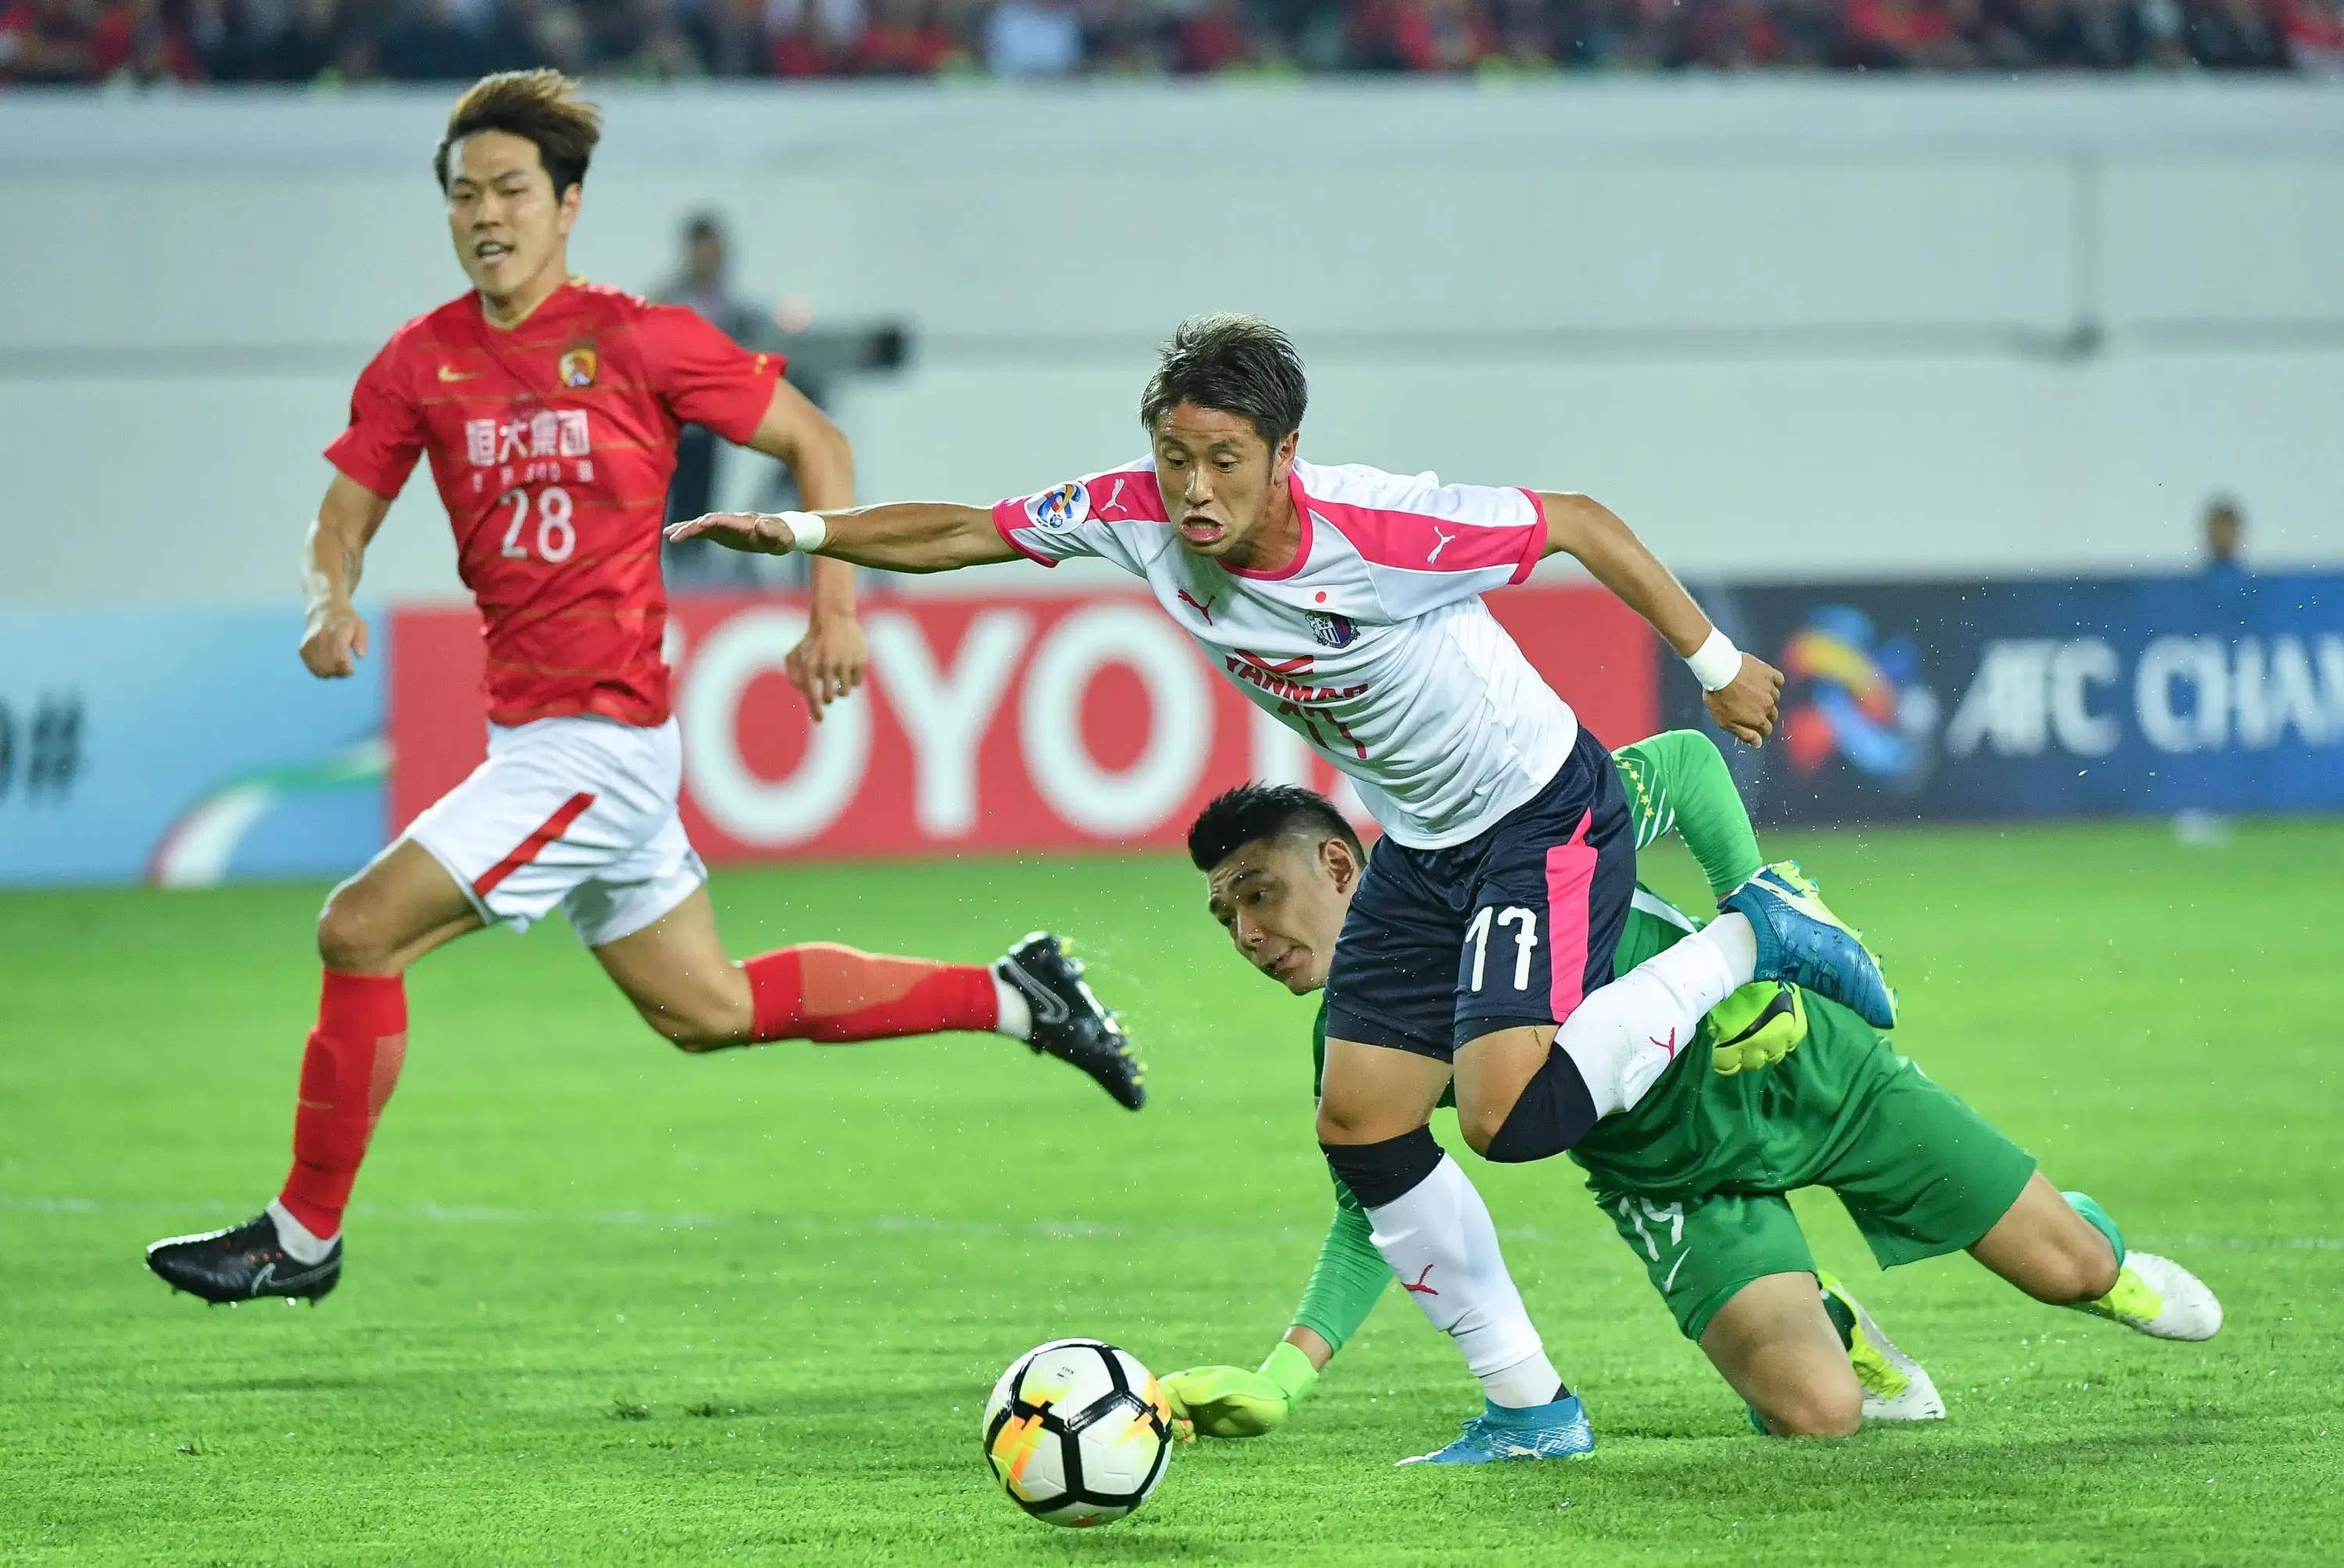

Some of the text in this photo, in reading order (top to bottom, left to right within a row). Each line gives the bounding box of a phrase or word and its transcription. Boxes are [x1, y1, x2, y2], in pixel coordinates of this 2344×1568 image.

[498, 486, 576, 563] 28
[661, 603, 1378, 847] OYO
[1948, 636, 2121, 756] AFC
[1465, 905, 1538, 992] 17
[1618, 1195, 1685, 1262] 19
